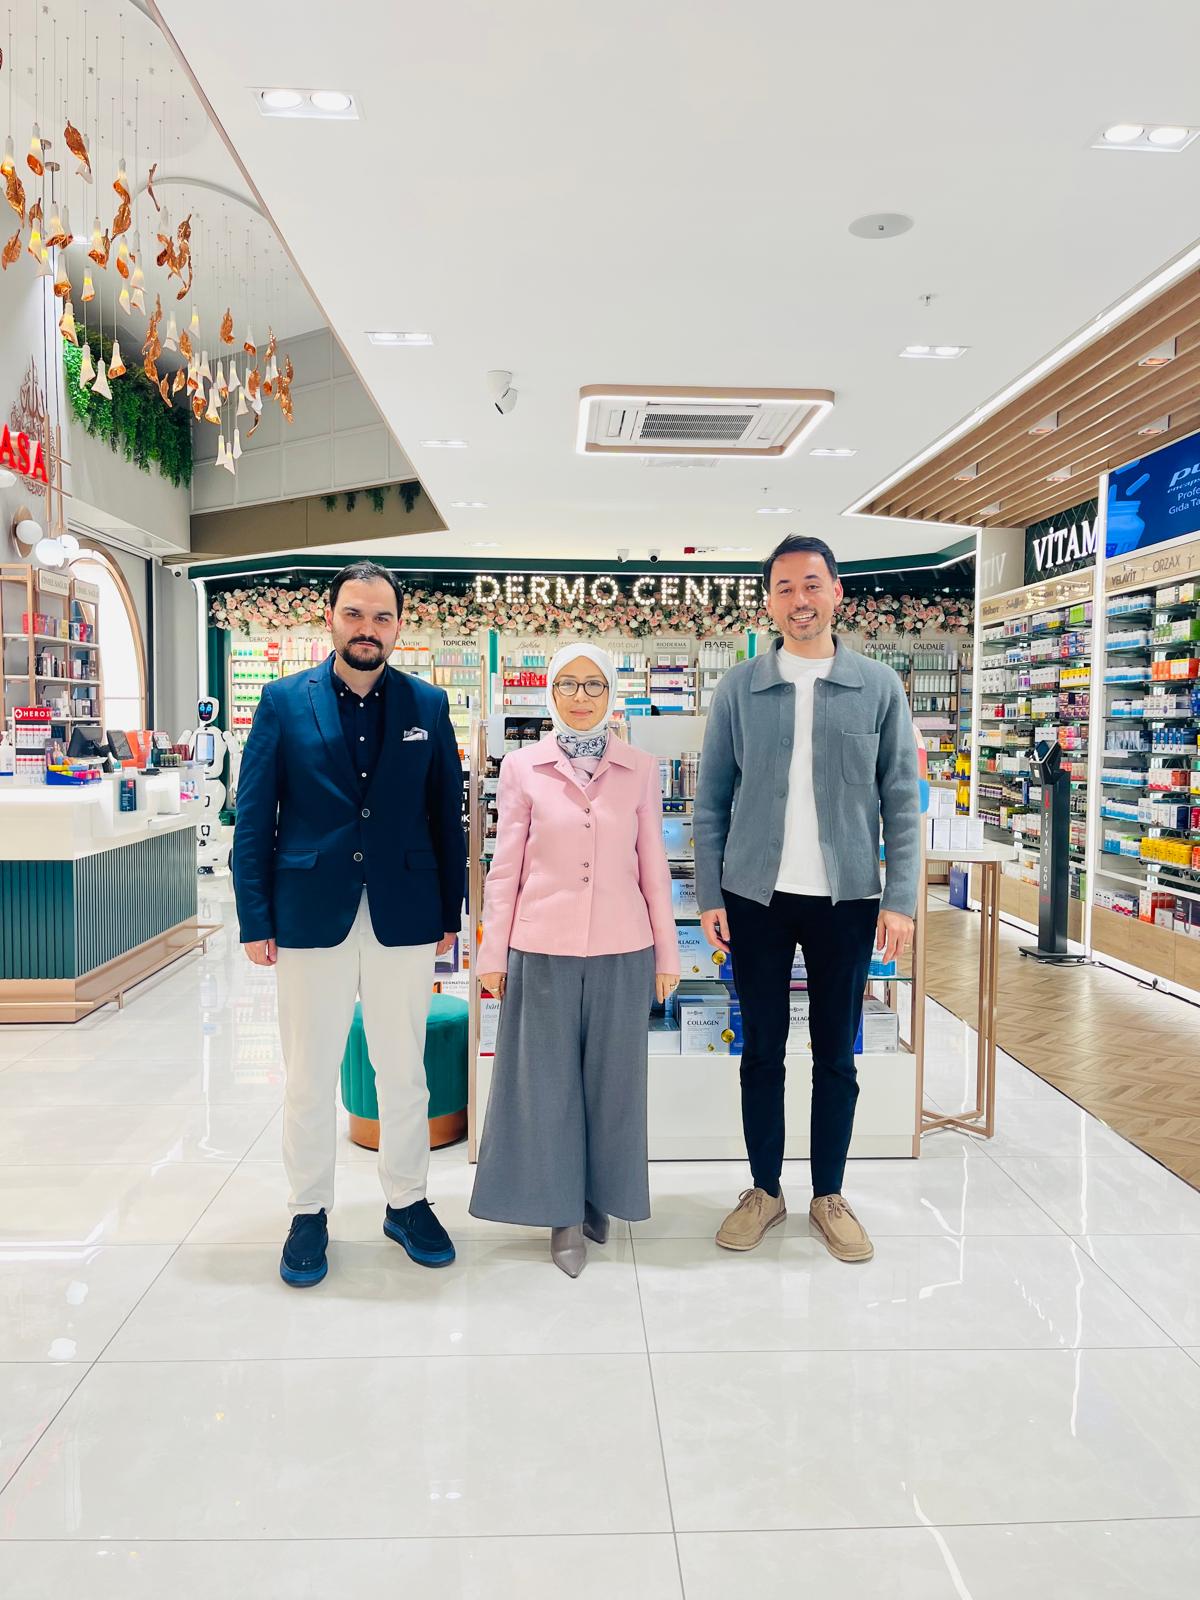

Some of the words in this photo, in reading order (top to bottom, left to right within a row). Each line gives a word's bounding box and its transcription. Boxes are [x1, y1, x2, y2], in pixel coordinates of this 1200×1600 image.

[0, 423, 49, 483] ASA
[1152, 555, 1181, 573] ORZAX
[476, 576, 618, 605] DERMO
[633, 577, 768, 607] CENTE
